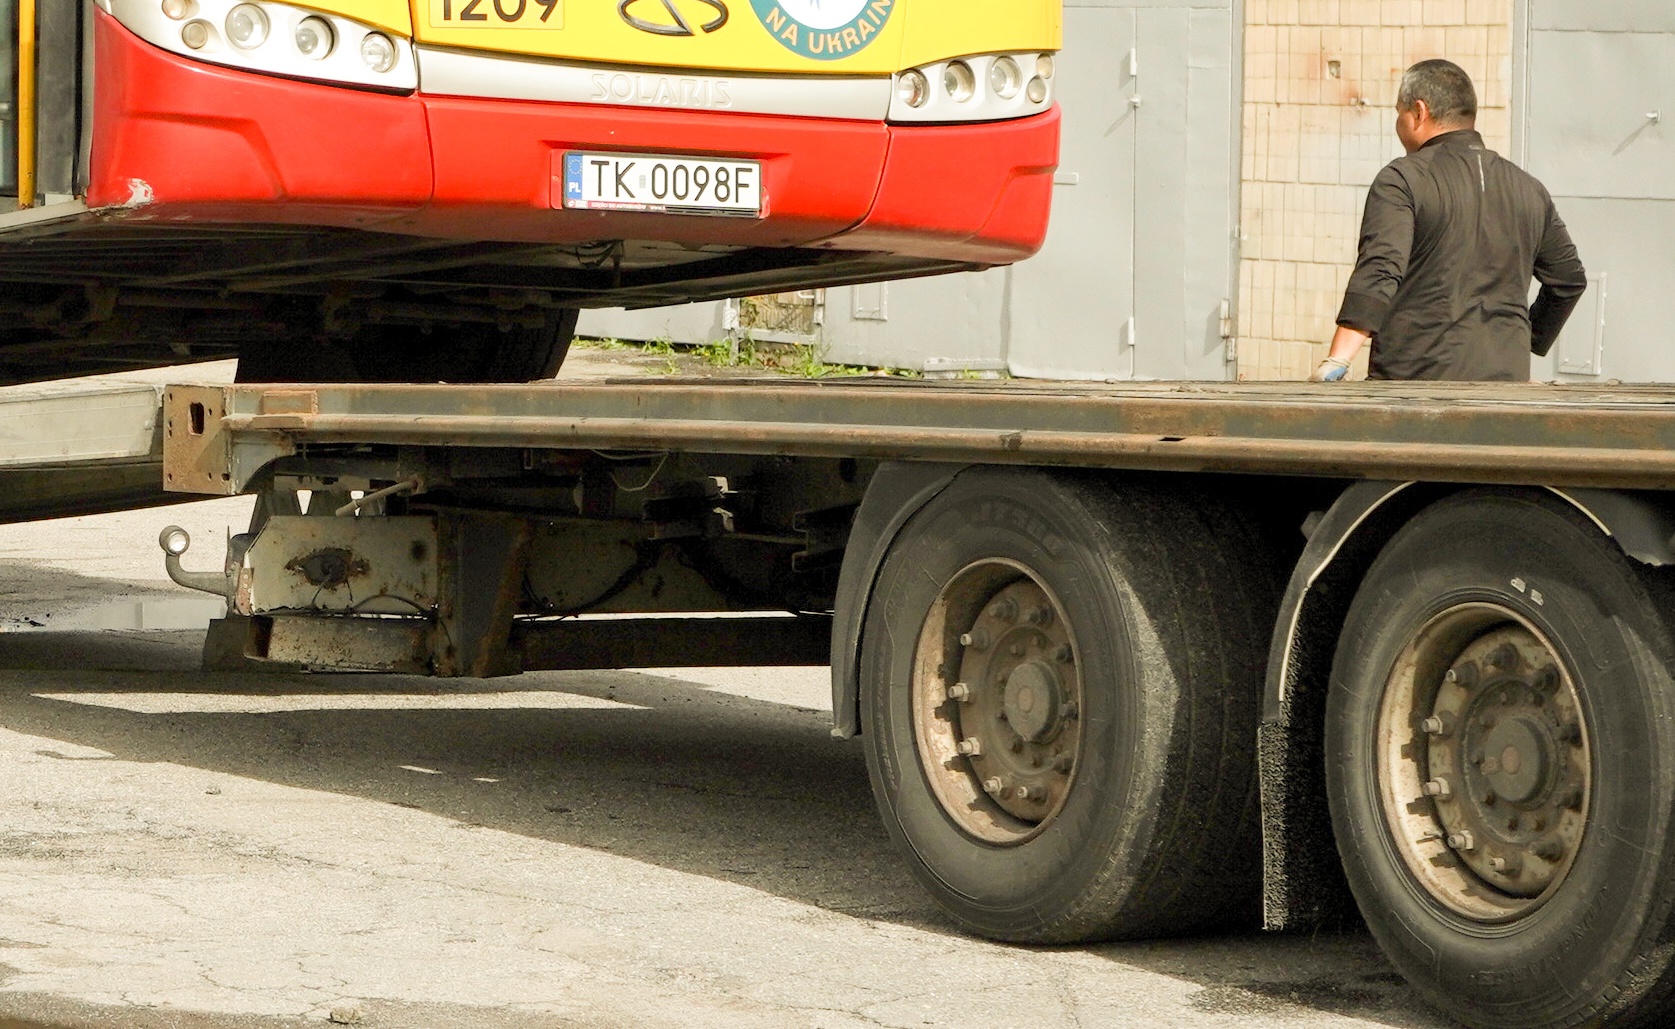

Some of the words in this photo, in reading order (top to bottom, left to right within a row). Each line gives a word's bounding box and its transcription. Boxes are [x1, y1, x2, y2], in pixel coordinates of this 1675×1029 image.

[765, 7, 799, 47] NA
[591, 73, 733, 109] SOLARIS
[568, 182, 581, 193] PL
[590, 159, 636, 199] TK
[651, 163, 753, 203] 0098F
